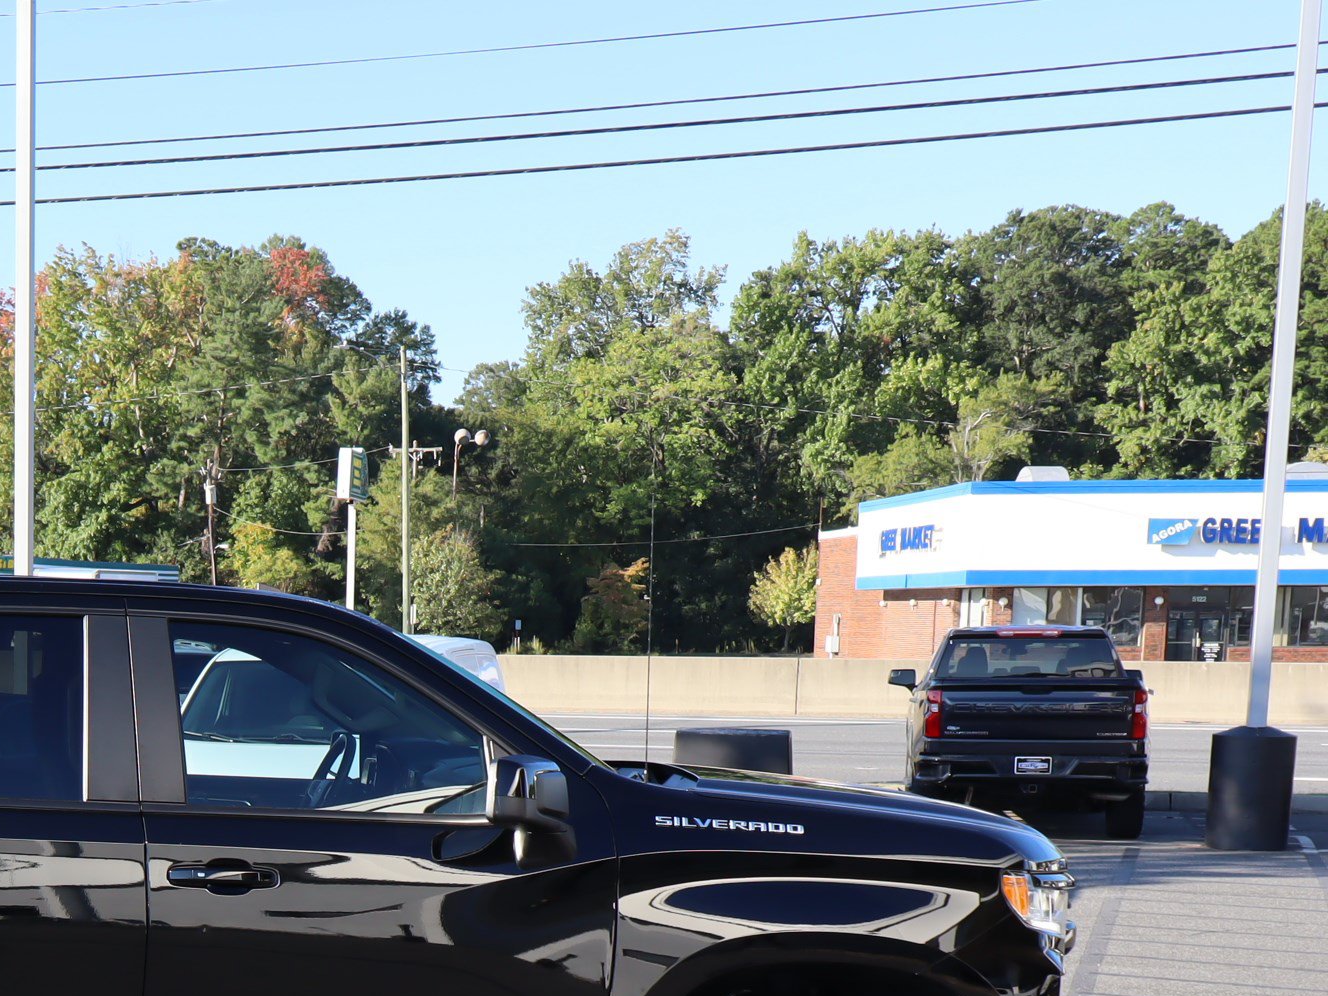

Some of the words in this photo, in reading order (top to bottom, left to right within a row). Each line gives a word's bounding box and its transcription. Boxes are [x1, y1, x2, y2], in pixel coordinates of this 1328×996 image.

[1151, 519, 1193, 544] AGORA
[1201, 517, 1263, 544] GREE
[1192, 595, 1207, 603] 5122
[655, 815, 805, 835] SILVERADO
